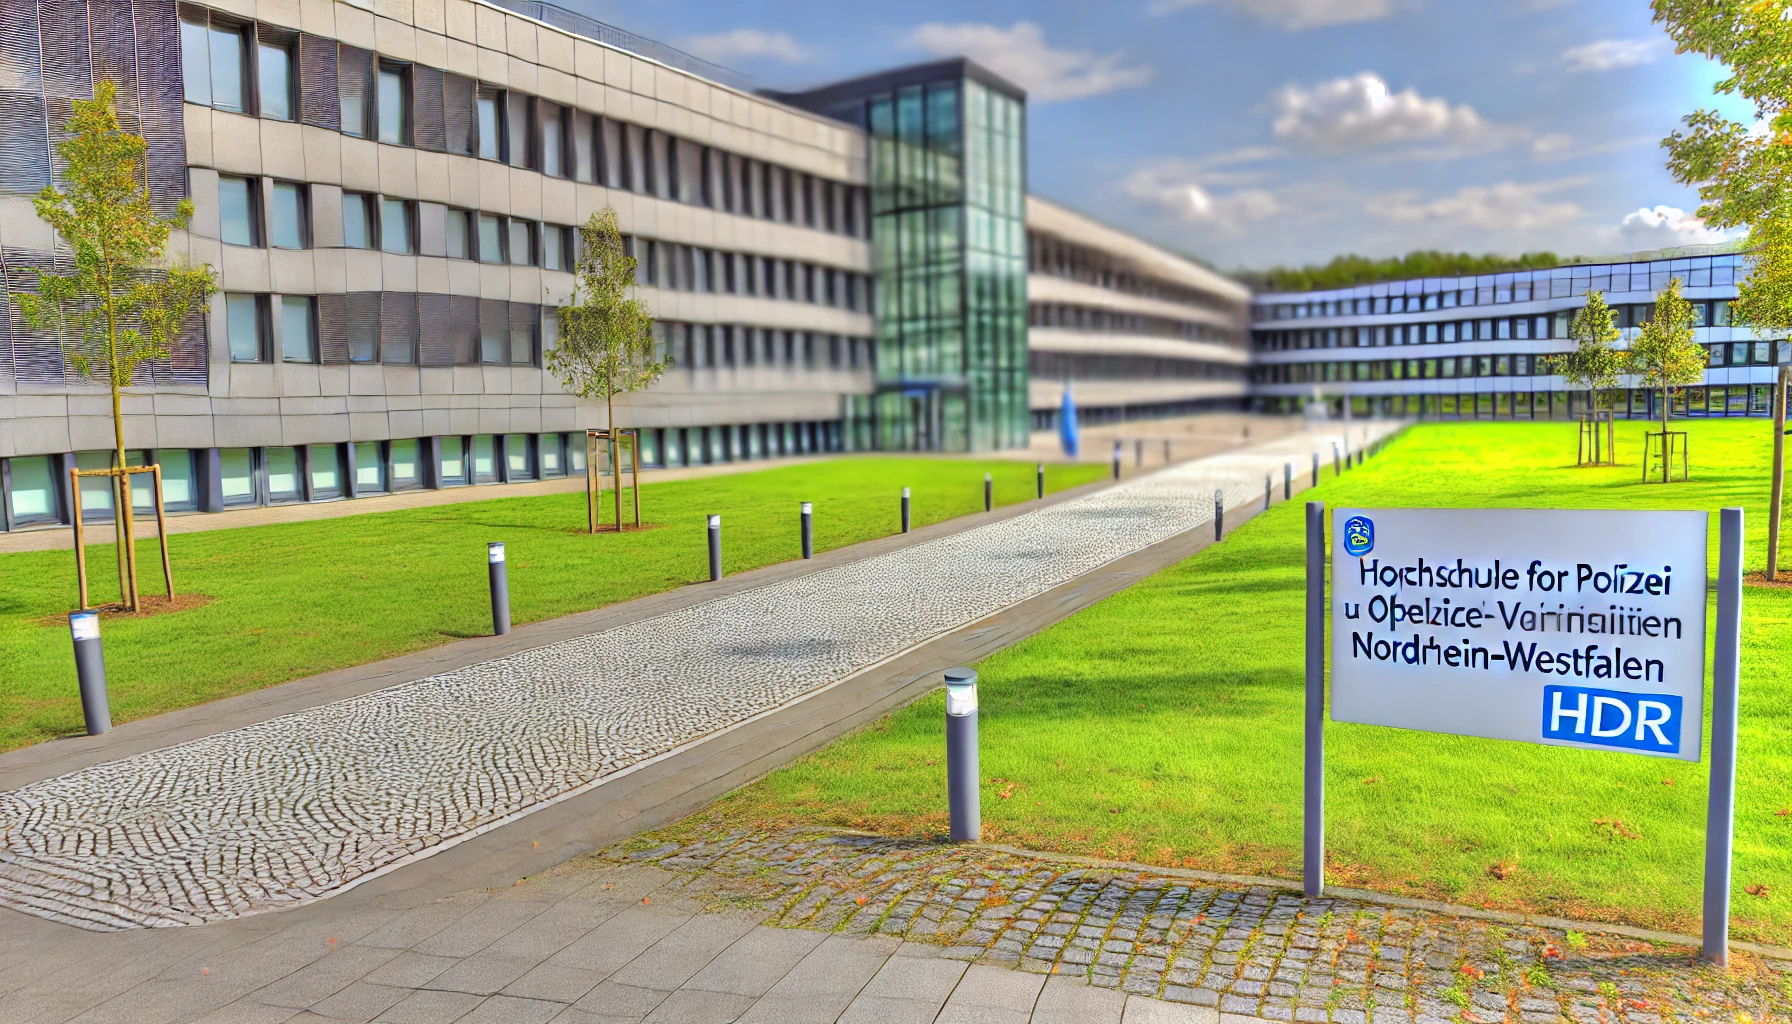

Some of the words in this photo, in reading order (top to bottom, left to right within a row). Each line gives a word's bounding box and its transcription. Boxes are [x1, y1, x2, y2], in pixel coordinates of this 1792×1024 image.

[1527, 560, 1568, 592] for
[1576, 563, 1672, 595] Polizei
[1550, 691, 1674, 746] HDR
